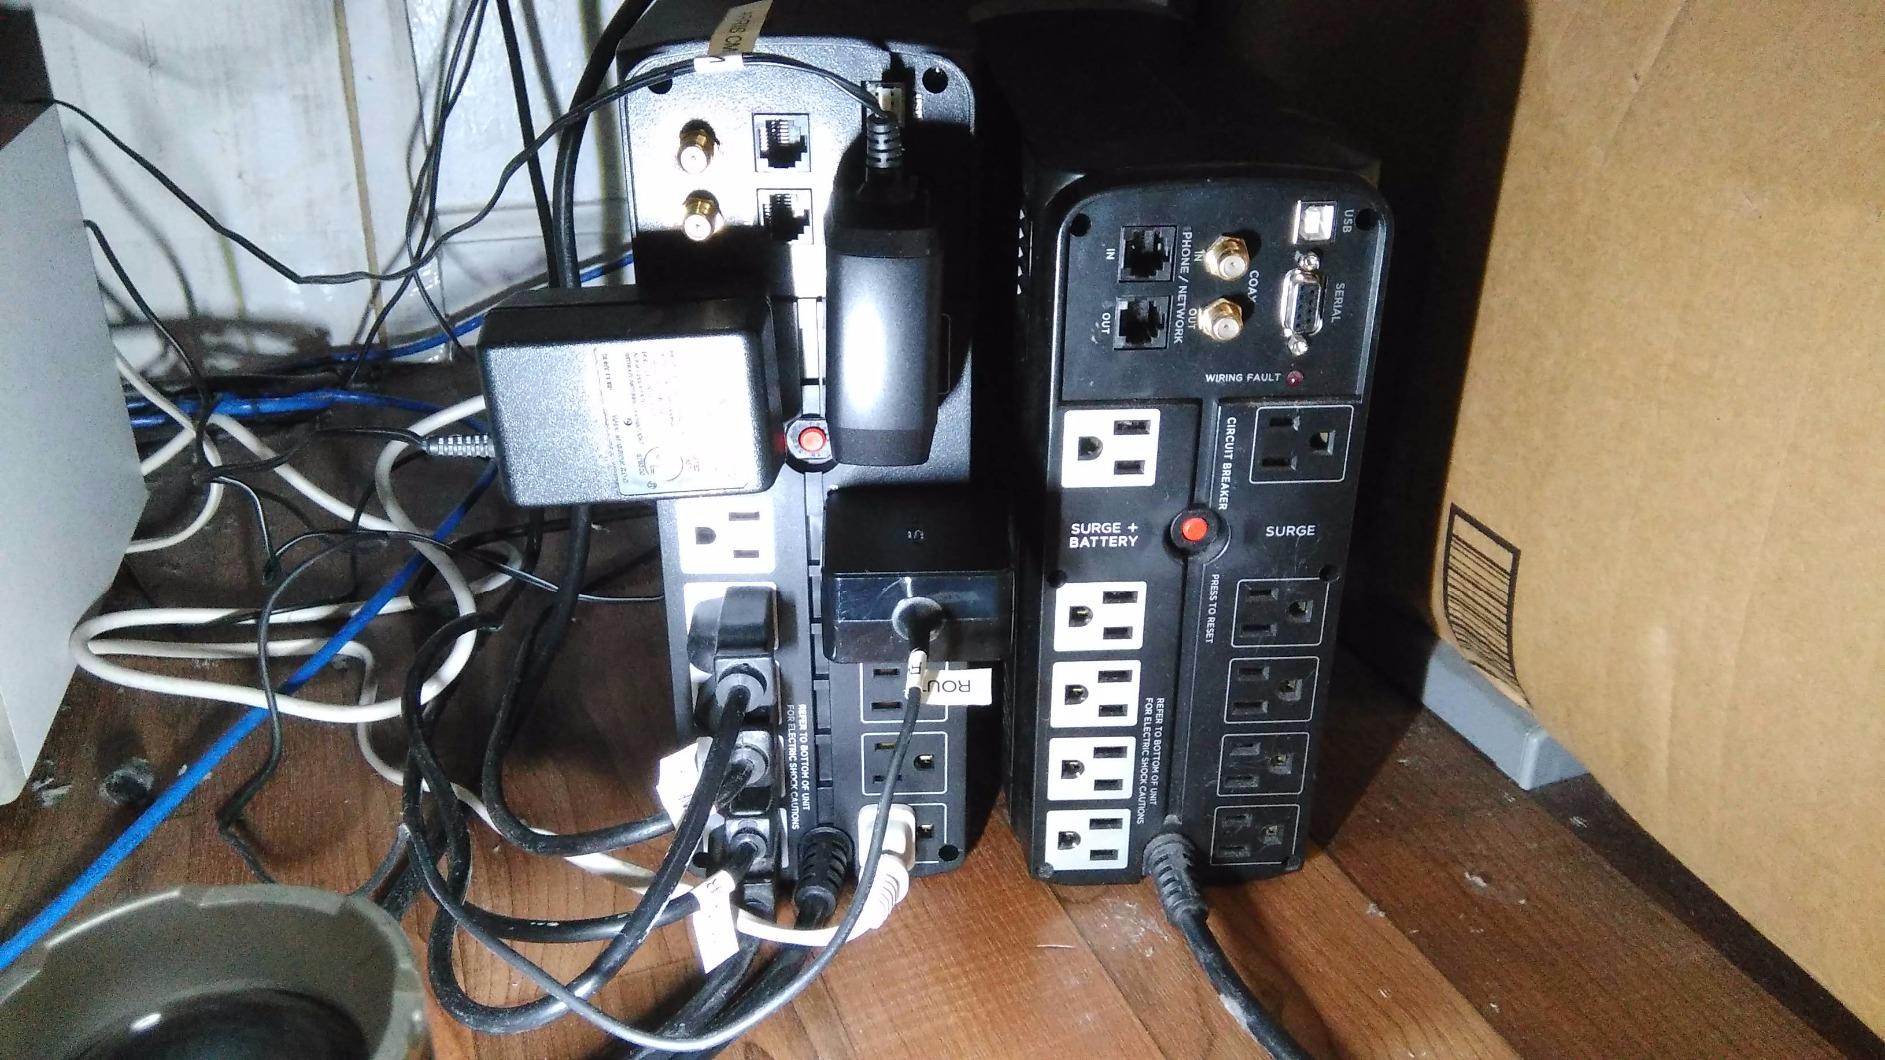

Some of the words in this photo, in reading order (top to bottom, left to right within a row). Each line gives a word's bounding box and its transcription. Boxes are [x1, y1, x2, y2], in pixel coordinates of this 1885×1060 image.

[1342, 209, 1354, 233] USB
[1106, 248, 1116, 261] IN
[1180, 231, 1193, 274] PHONE
[1194, 249, 1206, 262] IN
[1173, 285, 1188, 344] NETWORK
[1331, 283, 1345, 323] SERIAL
[1101, 312, 1111, 335] OUT
[1188, 308, 1197, 330] OUT
[1205, 373, 1243, 383] WIRING
[1246, 373, 1282, 383] FAULT
[1224, 416, 1238, 461] CIRCUIT
[1218, 463, 1233, 511] BREAKER
[1071, 522, 1122, 535] SURGE
[1127, 523, 1139, 533] +
[1265, 525, 1317, 537] SURGE
[1069, 535, 1139, 549] BATTERY
[1209, 573, 1221, 602] PRESS
[1208, 603, 1217, 614] TO
[1205, 616, 1217, 644] RESET
[786, 704, 796, 721] FOR
[799, 704, 808, 730] REFER
[1144, 697, 1154, 715] FOR
[1155, 697, 1165, 724] REFER
[788, 723, 798, 762] ELECTRIC
[799, 731, 808, 743] TO
[1141, 716, 1152, 756] ELECTRIC
[1154, 725, 1163, 738] TO
[800, 745, 810, 779] BOTTOM
[1151, 739, 1162, 773] BOTTOM
[789, 763, 799, 790] SHOCK
[1140, 757, 1150, 784] SHOCK
[1151, 774, 1159, 785] OF
[801, 780, 810, 792] OF
[1149, 787, 1158, 806] UNIT
[790, 791, 800, 831] CAUTIONS
[801, 793, 811, 811] UNIT
[1136, 785, 1147, 825] CAUTIONS
